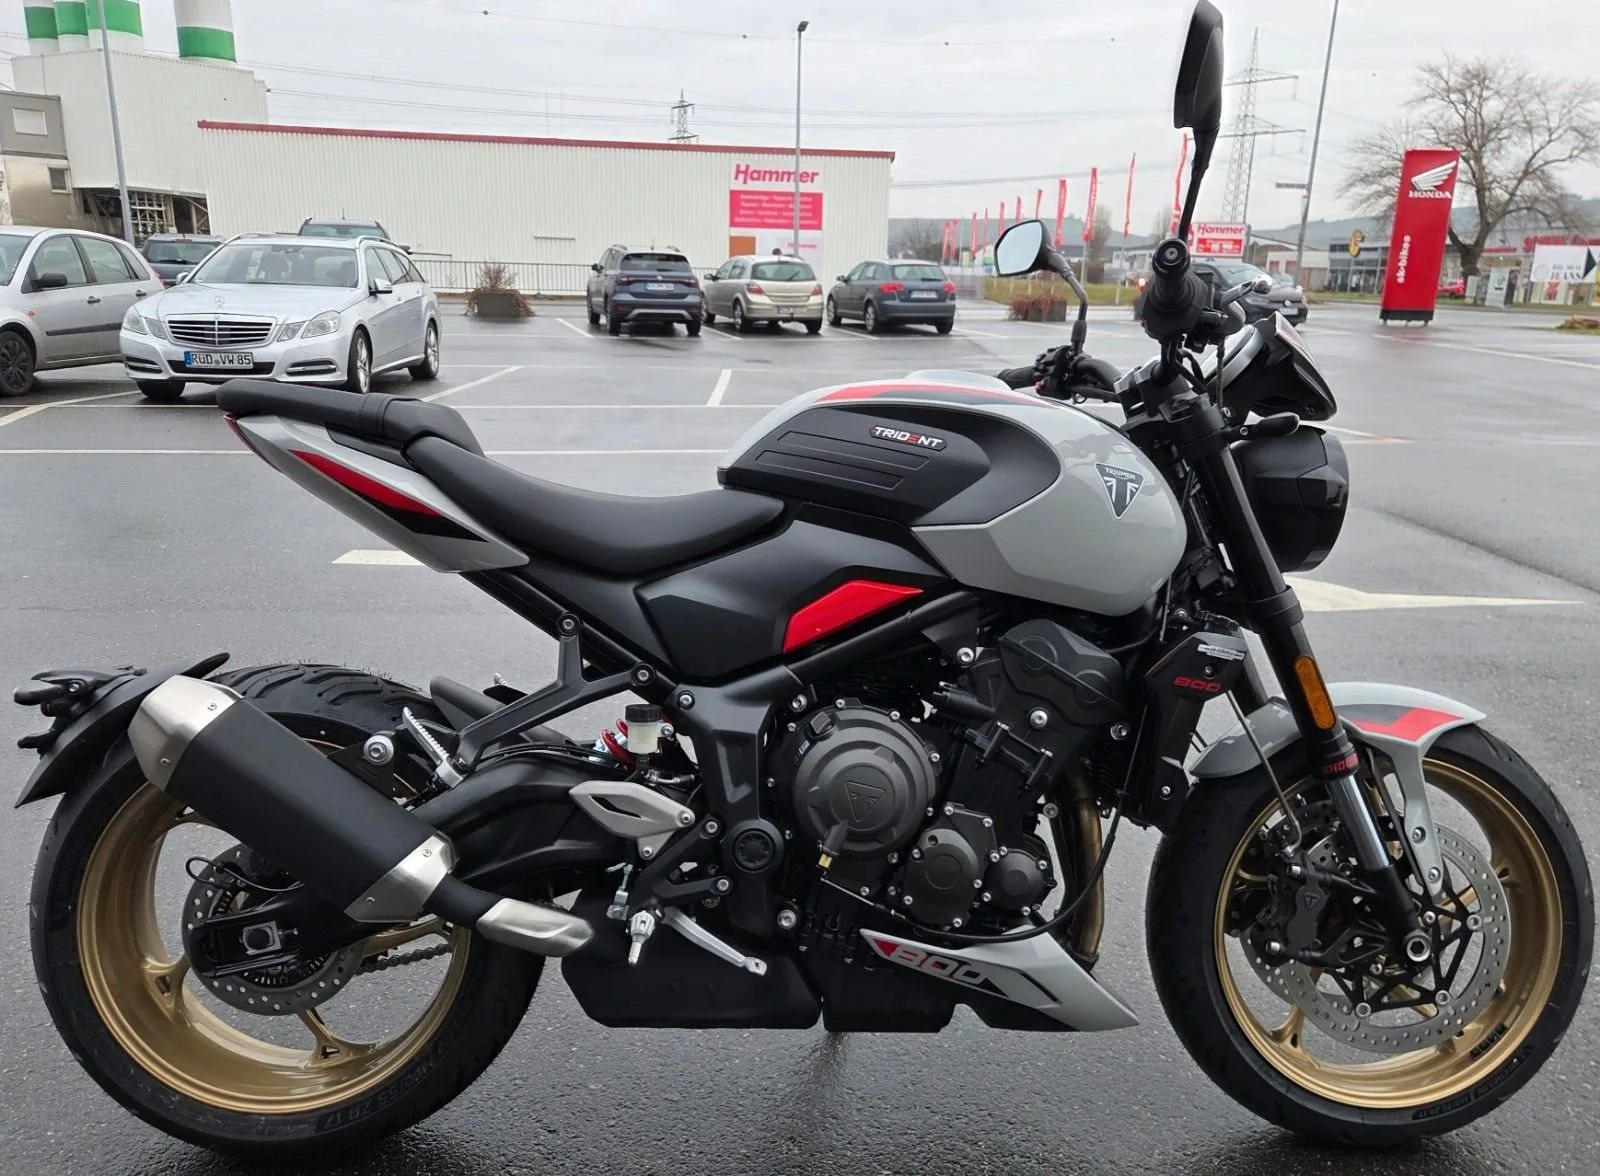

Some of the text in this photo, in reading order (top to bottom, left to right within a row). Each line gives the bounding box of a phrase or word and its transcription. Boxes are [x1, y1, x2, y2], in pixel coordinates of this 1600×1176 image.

[734, 163, 819, 185] Hammer
[1408, 190, 1452, 199] HONDA
[1198, 223, 1244, 235] Hammer
[191, 353, 251, 365] RÜD VW 85
[874, 426, 943, 447] TRIDENT
[1105, 467, 1136, 480] TRIUMPH
[1173, 676, 1222, 693] 800
[889, 944, 987, 985] 800
